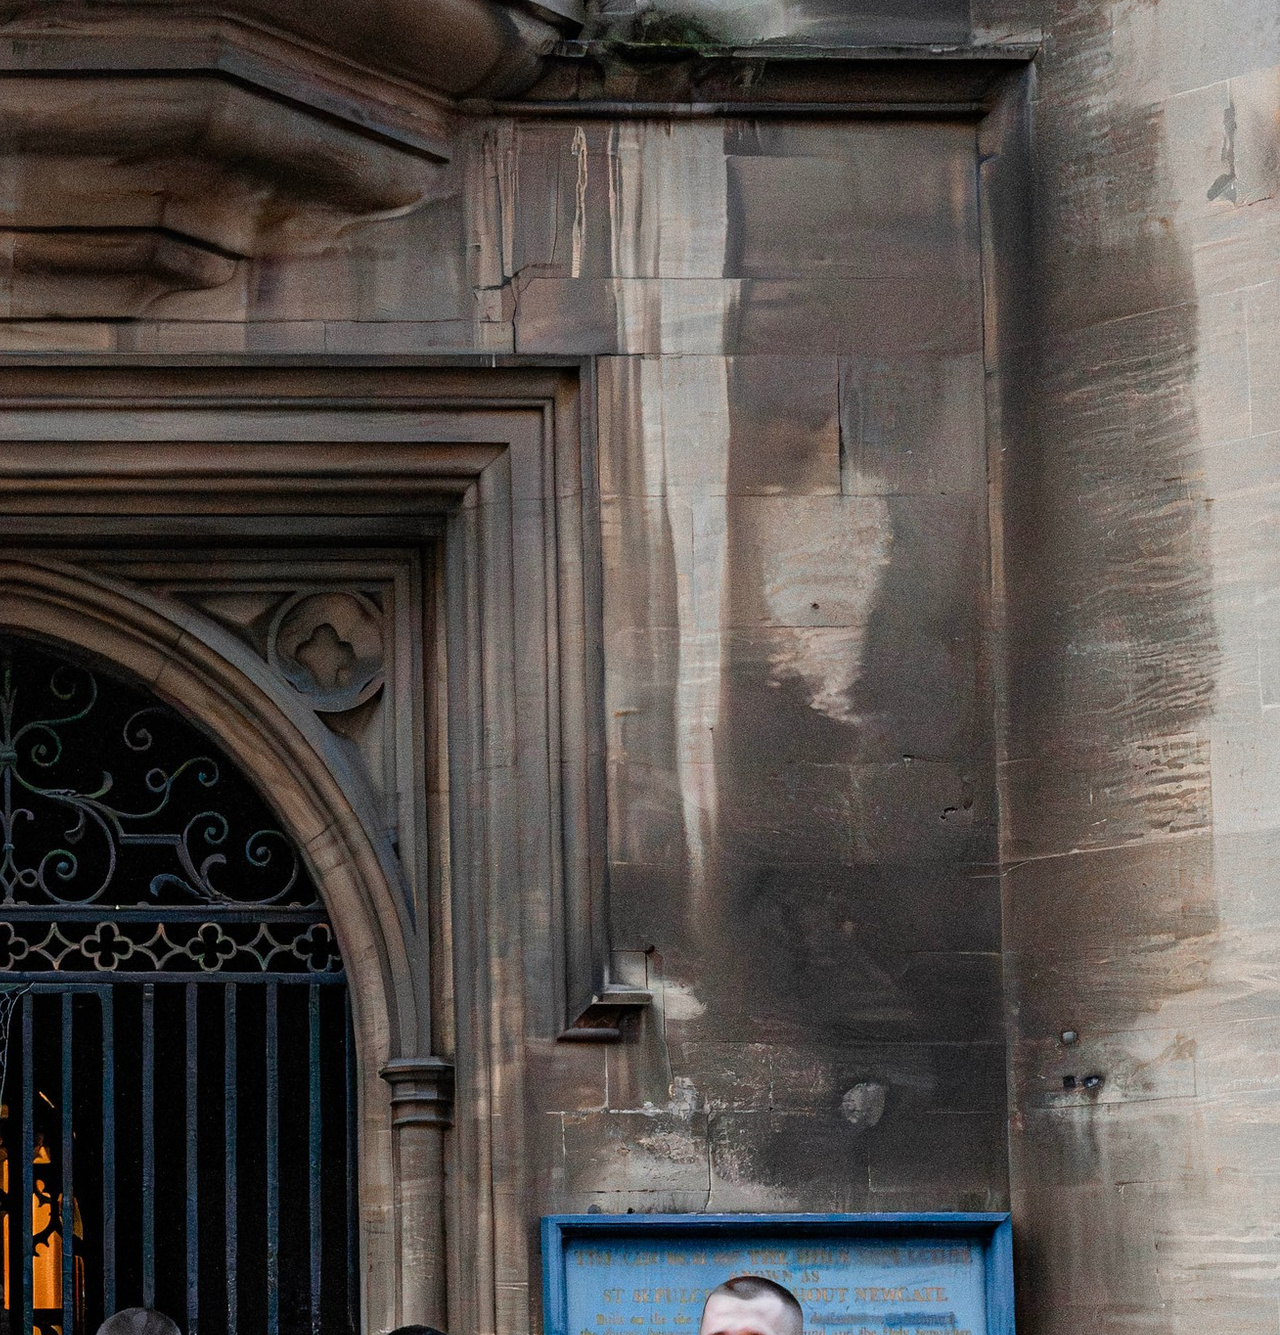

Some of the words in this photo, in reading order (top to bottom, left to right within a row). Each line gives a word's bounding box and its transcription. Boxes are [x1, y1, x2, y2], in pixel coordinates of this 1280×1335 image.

[801, 1269, 821, 1284] AS
[602, 1287, 625, 1304] ST
[794, 1286, 849, 1304] HOUT
